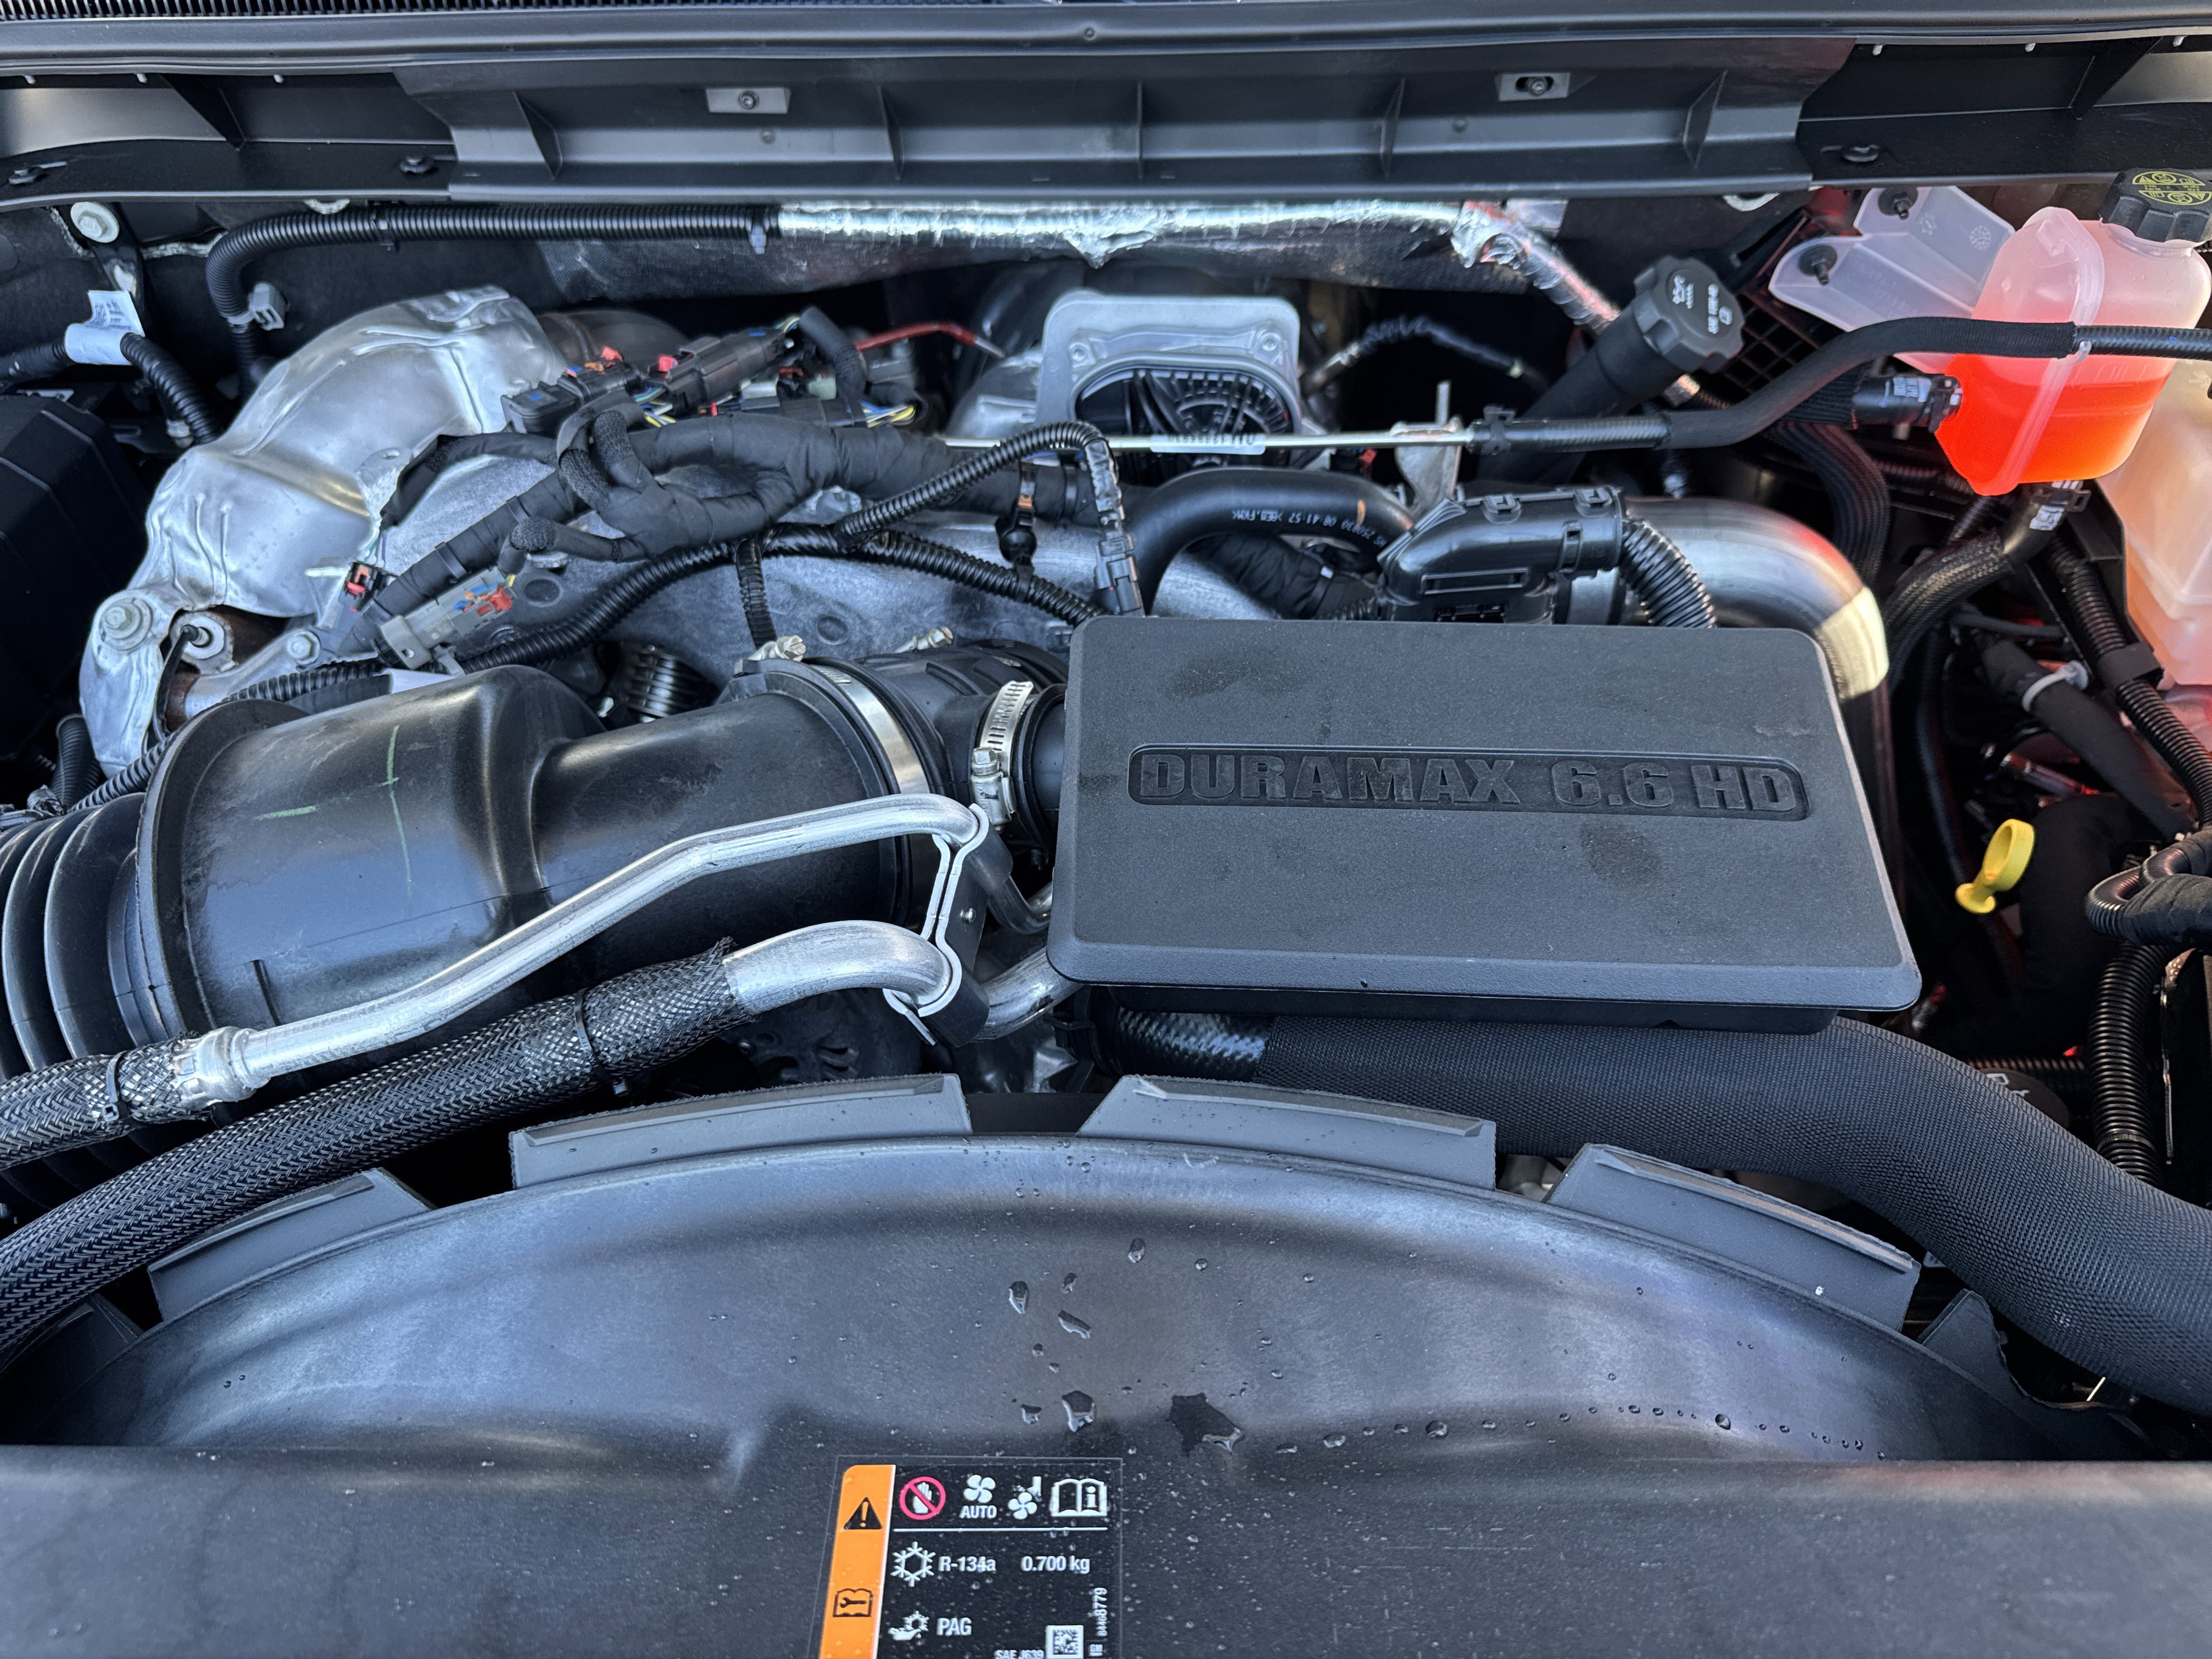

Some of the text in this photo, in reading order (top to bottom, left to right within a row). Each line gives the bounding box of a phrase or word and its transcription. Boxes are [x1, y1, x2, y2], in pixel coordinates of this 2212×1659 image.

[1140, 753, 1797, 814] DURAMAX 6.6 HD
[960, 1505, 997, 1519] AUTO
[938, 1556, 1090, 1574] R-134a 0.700 kg
[937, 1618, 972, 1636] PAG
